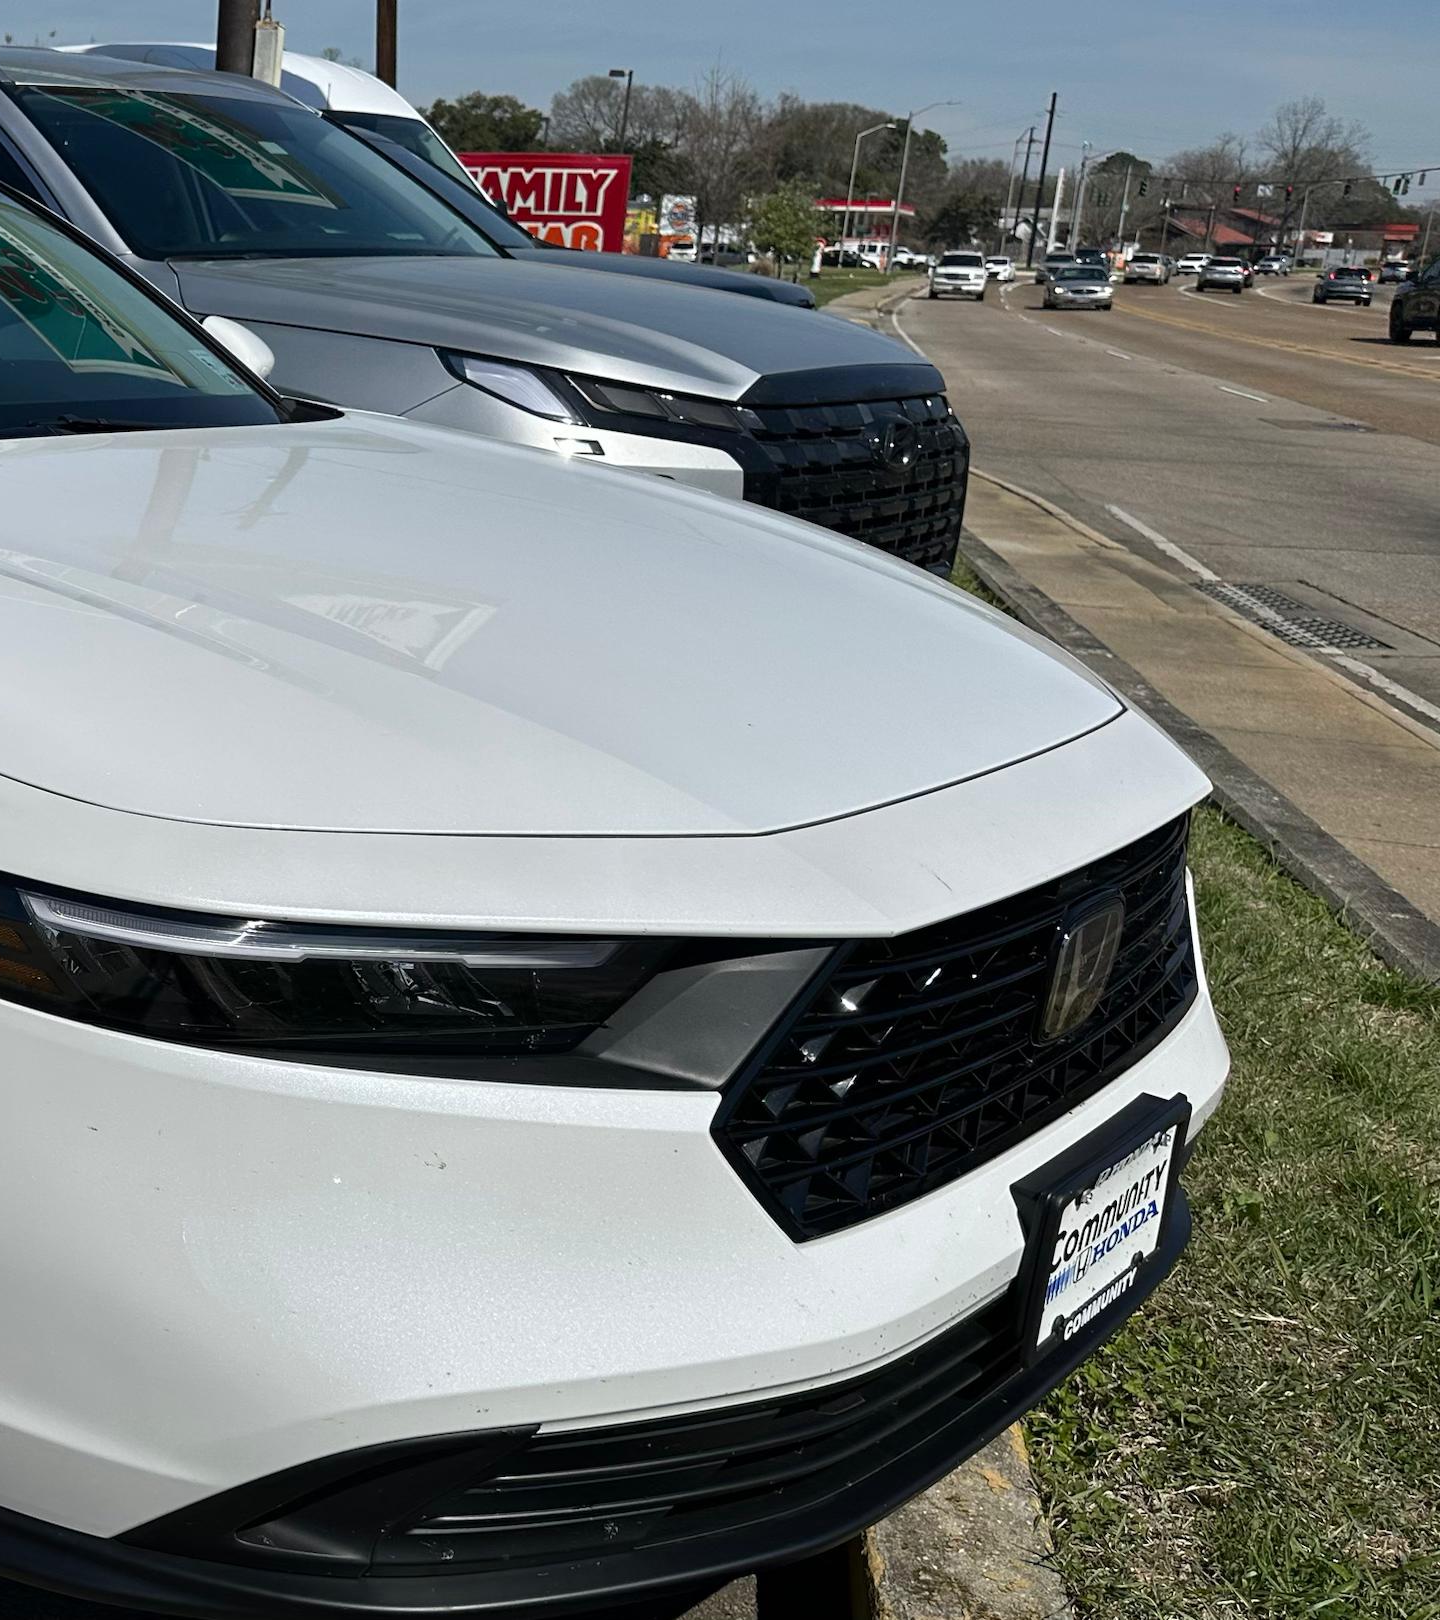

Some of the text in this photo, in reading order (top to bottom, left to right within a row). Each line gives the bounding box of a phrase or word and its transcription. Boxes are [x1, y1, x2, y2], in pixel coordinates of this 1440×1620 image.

[467, 167, 618, 216] AMILY
[1050, 1159, 1167, 1272] COMMUNITY
[1091, 1200, 1159, 1266] HONDA
[1064, 1267, 1137, 1340] COMMUNITY
